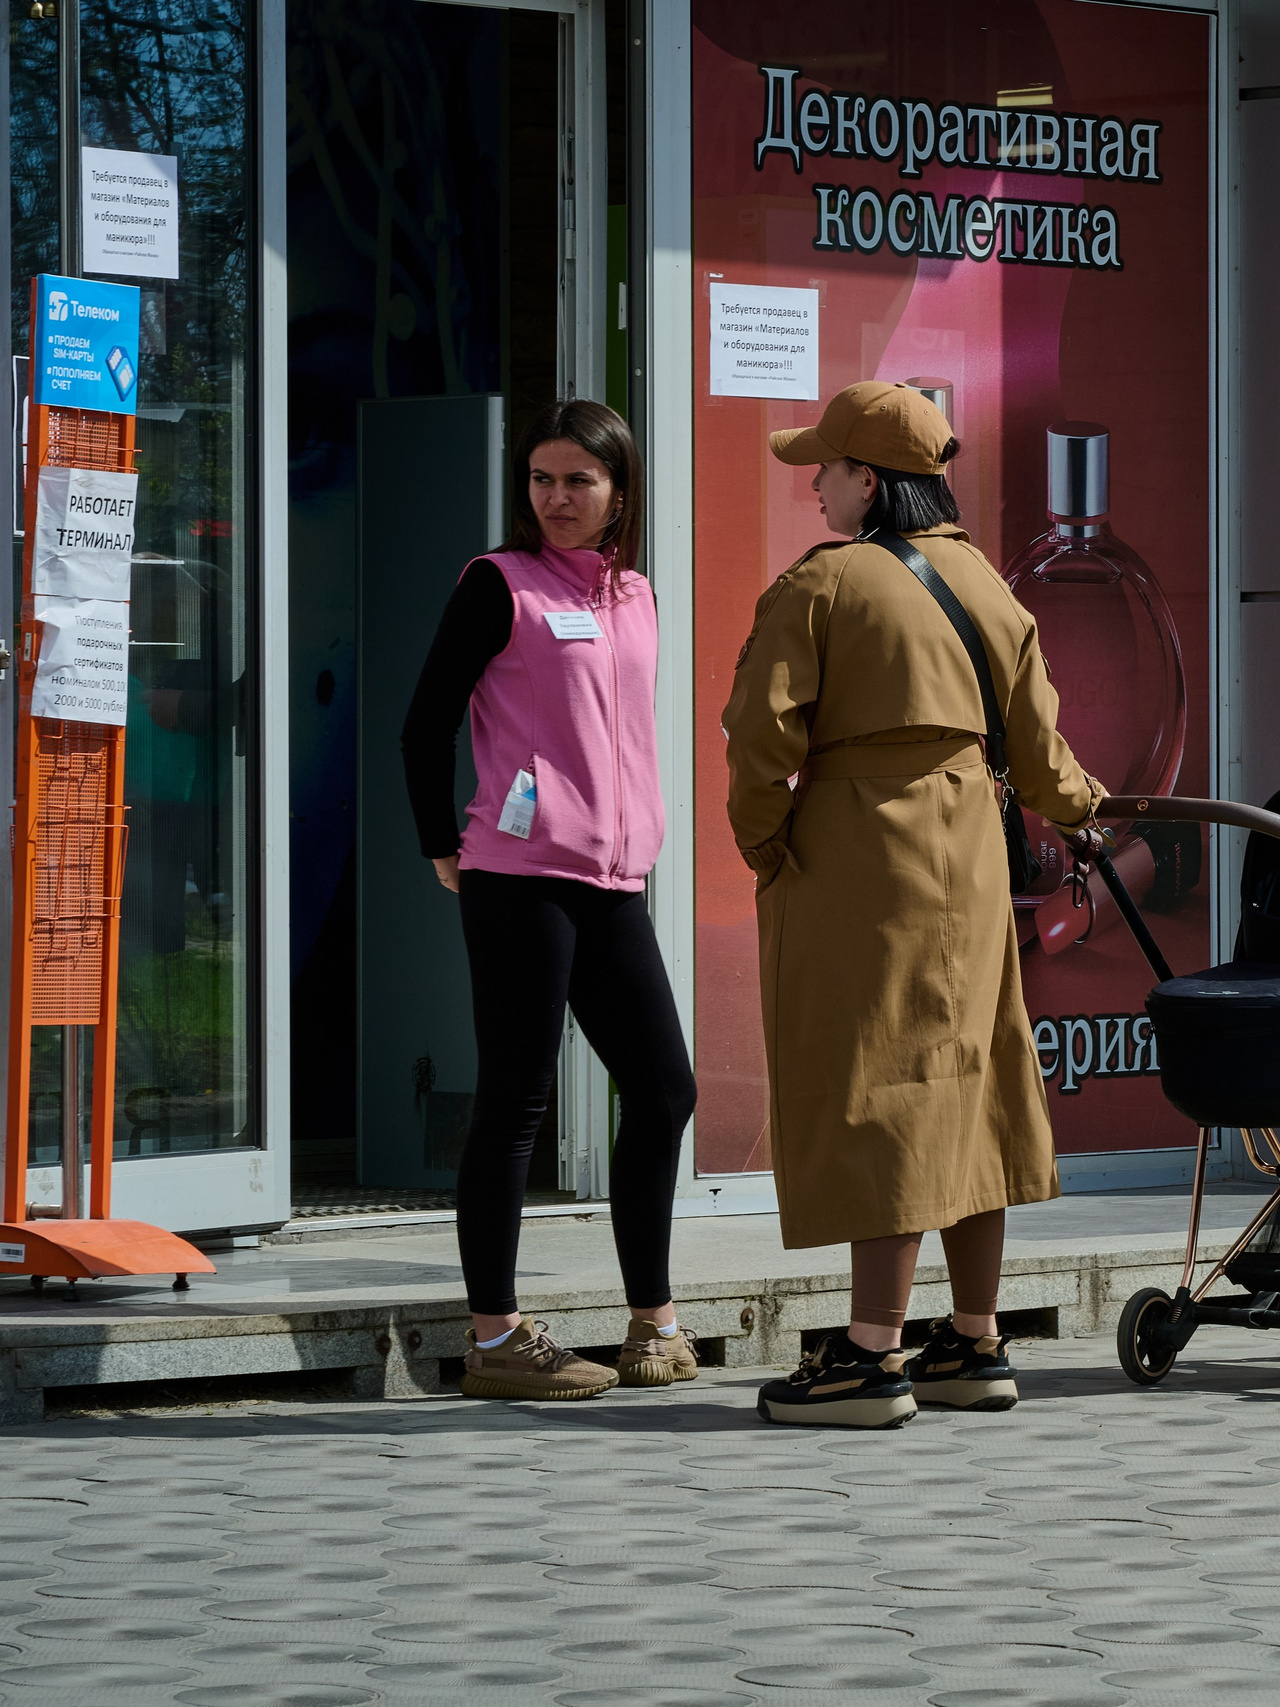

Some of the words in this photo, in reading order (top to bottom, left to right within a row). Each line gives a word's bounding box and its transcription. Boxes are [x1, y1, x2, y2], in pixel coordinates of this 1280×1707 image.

[754, 66, 1162, 182] Декоративная
[91, 170, 128, 185] Требуется
[128, 176, 163, 190] продавец
[164, 180, 169, 188] в
[90, 192, 121, 203] магазин
[100, 211, 152, 226] оборудования
[153, 218, 167, 228] для
[814, 187, 1122, 268] косметика
[70, 300, 120, 322] Телеком
[721, 303, 761, 315] Требуется
[762, 307, 802, 319] продавец
[803, 310, 808, 318] в
[720, 323, 753, 332] магазин
[755, 323, 810, 336] «Материалов
[54, 335, 90, 349] ПРОДАЕМ
[731, 340, 789, 352] оборудования
[790, 345, 806, 353] для
[53, 347, 95, 362] SIM-КАРТЫ
[736, 360, 793, 371] маникюра»!!!
[52, 366, 102, 381] ПОПОЛНЯЕМ
[51, 379, 72, 391] СЧЕТ
[69, 495, 134, 517] РАБОТАЕТ
[56, 528, 131, 551] ТЕРМИНАЛ
[75, 615, 123, 630] Поступления
[77, 637, 123, 651] подарочных
[74, 658, 124, 671] сертификатов
[51, 676, 101, 688] номиналом
[54, 694, 77, 707] 2000
[77, 700, 83, 708] и
[85, 697, 101, 709] 5000
[1034, 1017, 1161, 1089] ерия
